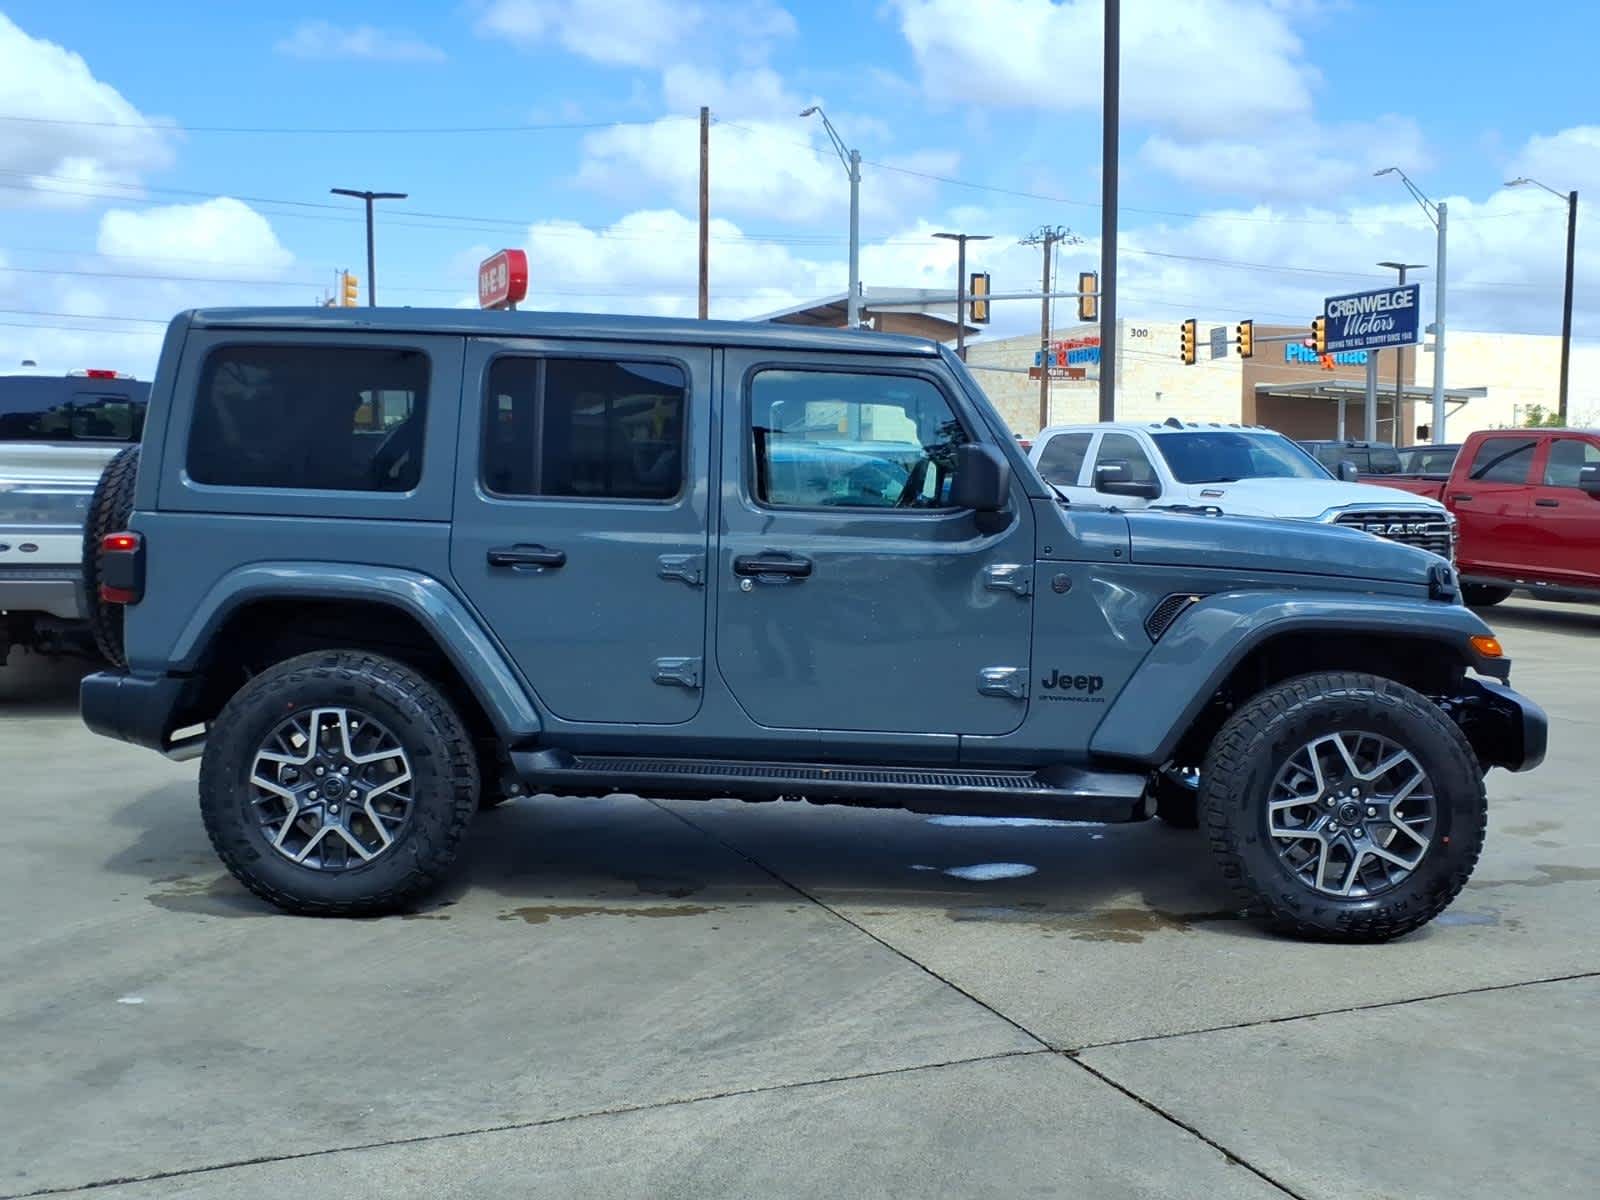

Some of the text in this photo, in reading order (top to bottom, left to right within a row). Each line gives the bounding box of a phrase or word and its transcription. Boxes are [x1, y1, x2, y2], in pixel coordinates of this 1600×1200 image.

[1327, 289, 1414, 318] CRENWELGE
[1130, 328, 1148, 338] 300
[1343, 312, 1395, 337] Motors
[1366, 523, 1426, 535] RAM
[1041, 669, 1104, 695] Jeep
